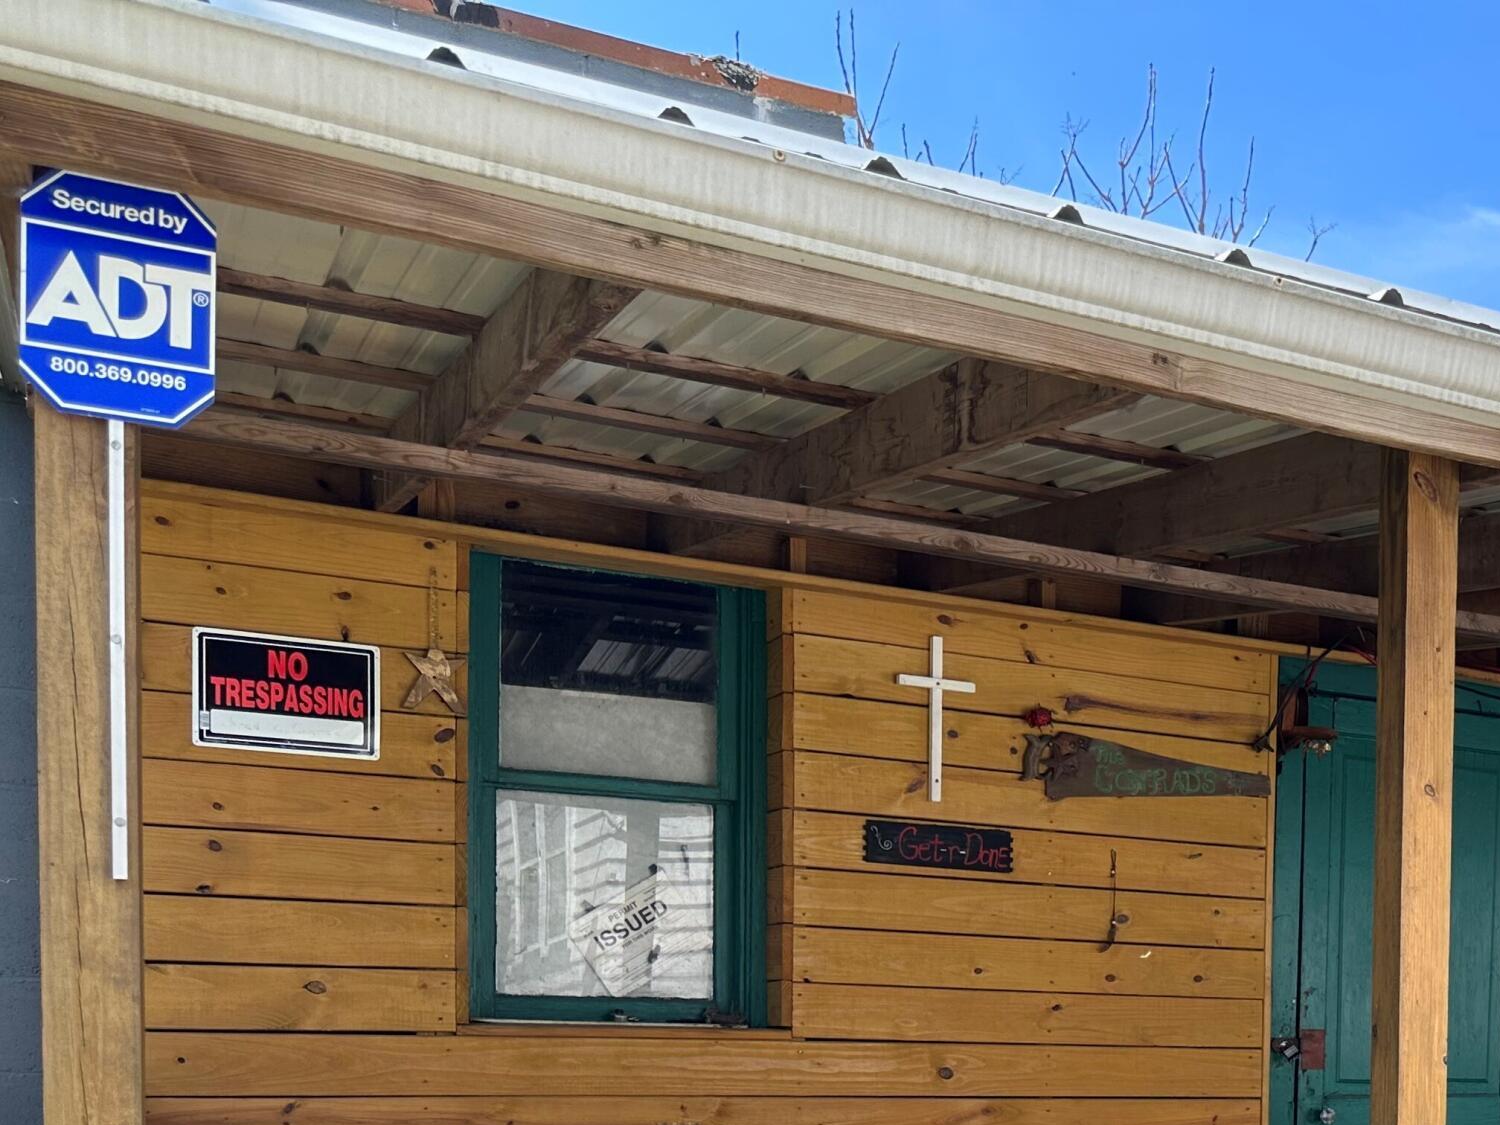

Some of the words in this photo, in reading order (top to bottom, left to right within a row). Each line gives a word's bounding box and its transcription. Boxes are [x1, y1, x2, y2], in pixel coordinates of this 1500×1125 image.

[52, 188, 155, 226] Secured
[158, 209, 188, 235] by
[50, 356, 187, 391] 800.369.0996
[267, 649, 308, 682] NO
[210, 676, 364, 718] TRESPASSING
[593, 900, 667, 951] ISSUED
[607, 901, 638, 923] PERMIT
